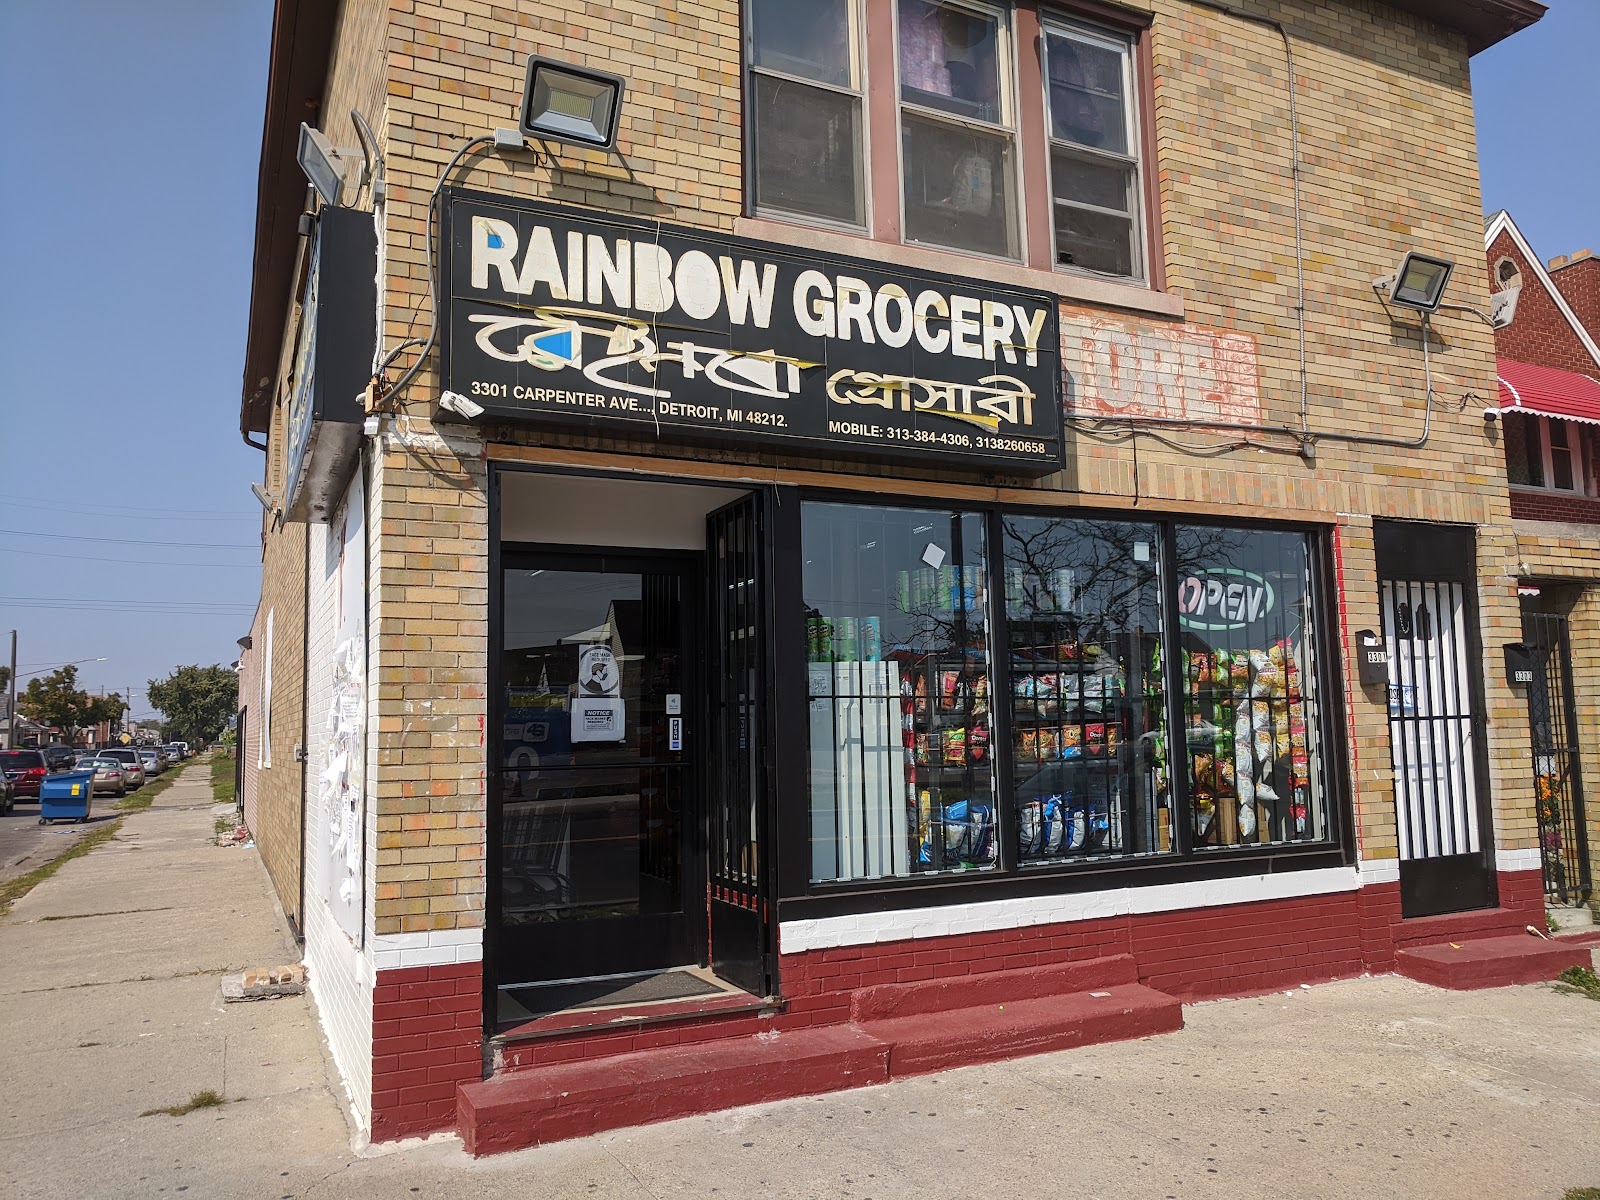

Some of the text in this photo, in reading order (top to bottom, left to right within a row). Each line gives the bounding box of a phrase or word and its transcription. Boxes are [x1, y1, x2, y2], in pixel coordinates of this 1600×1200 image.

[471, 215, 1048, 367] RAINBOW GROCERY
[470, 381, 508, 398] 3301
[513, 385, 606, 408] CARPENTER
[659, 401, 724, 423] DETROIT,
[726, 407, 743, 422] MI
[745, 410, 788, 427] 48212.
[828, 419, 1046, 454] MOBILE: 313-384-4306, 3138260658
[1178, 576, 1264, 623] OPEN
[1368, 652, 1387, 662] 3301
